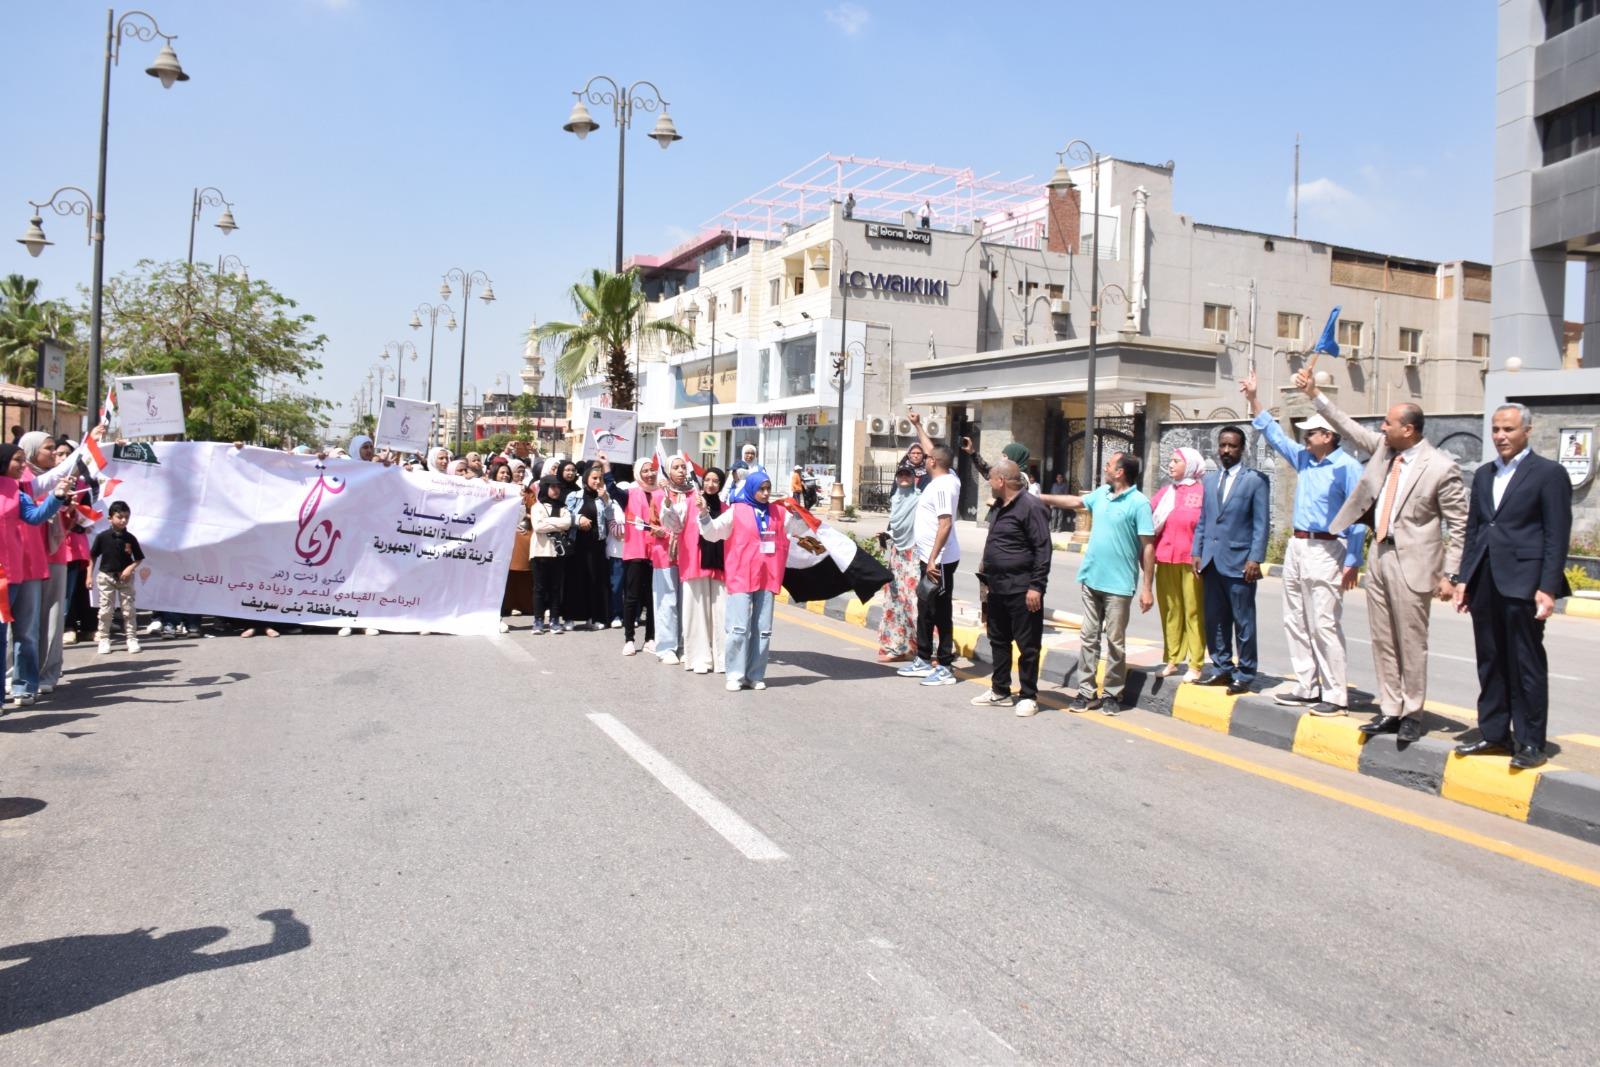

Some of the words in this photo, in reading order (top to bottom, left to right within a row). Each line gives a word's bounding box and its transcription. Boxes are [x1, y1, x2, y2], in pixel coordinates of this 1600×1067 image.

[451, 513, 476, 524] تحت
[396, 520, 440, 539] الفاضلة
[440, 528, 477, 545] السيدة
[373, 535, 416, 555] الجمهورية
[442, 545, 467, 559] فخامة
[416, 547, 440, 560] رئيس
[468, 548, 494, 565] قرينة
[182, 572, 224, 585] الفتيات
[227, 580, 254, 592] وعي
[258, 581, 294, 595] وزيادة
[299, 587, 330, 597] لدعم
[240, 596, 279, 612] سويف
[334, 592, 376, 603] القيادي
[379, 595, 421, 607] البرنامج
[306, 601, 360, 622] بمحافظة
